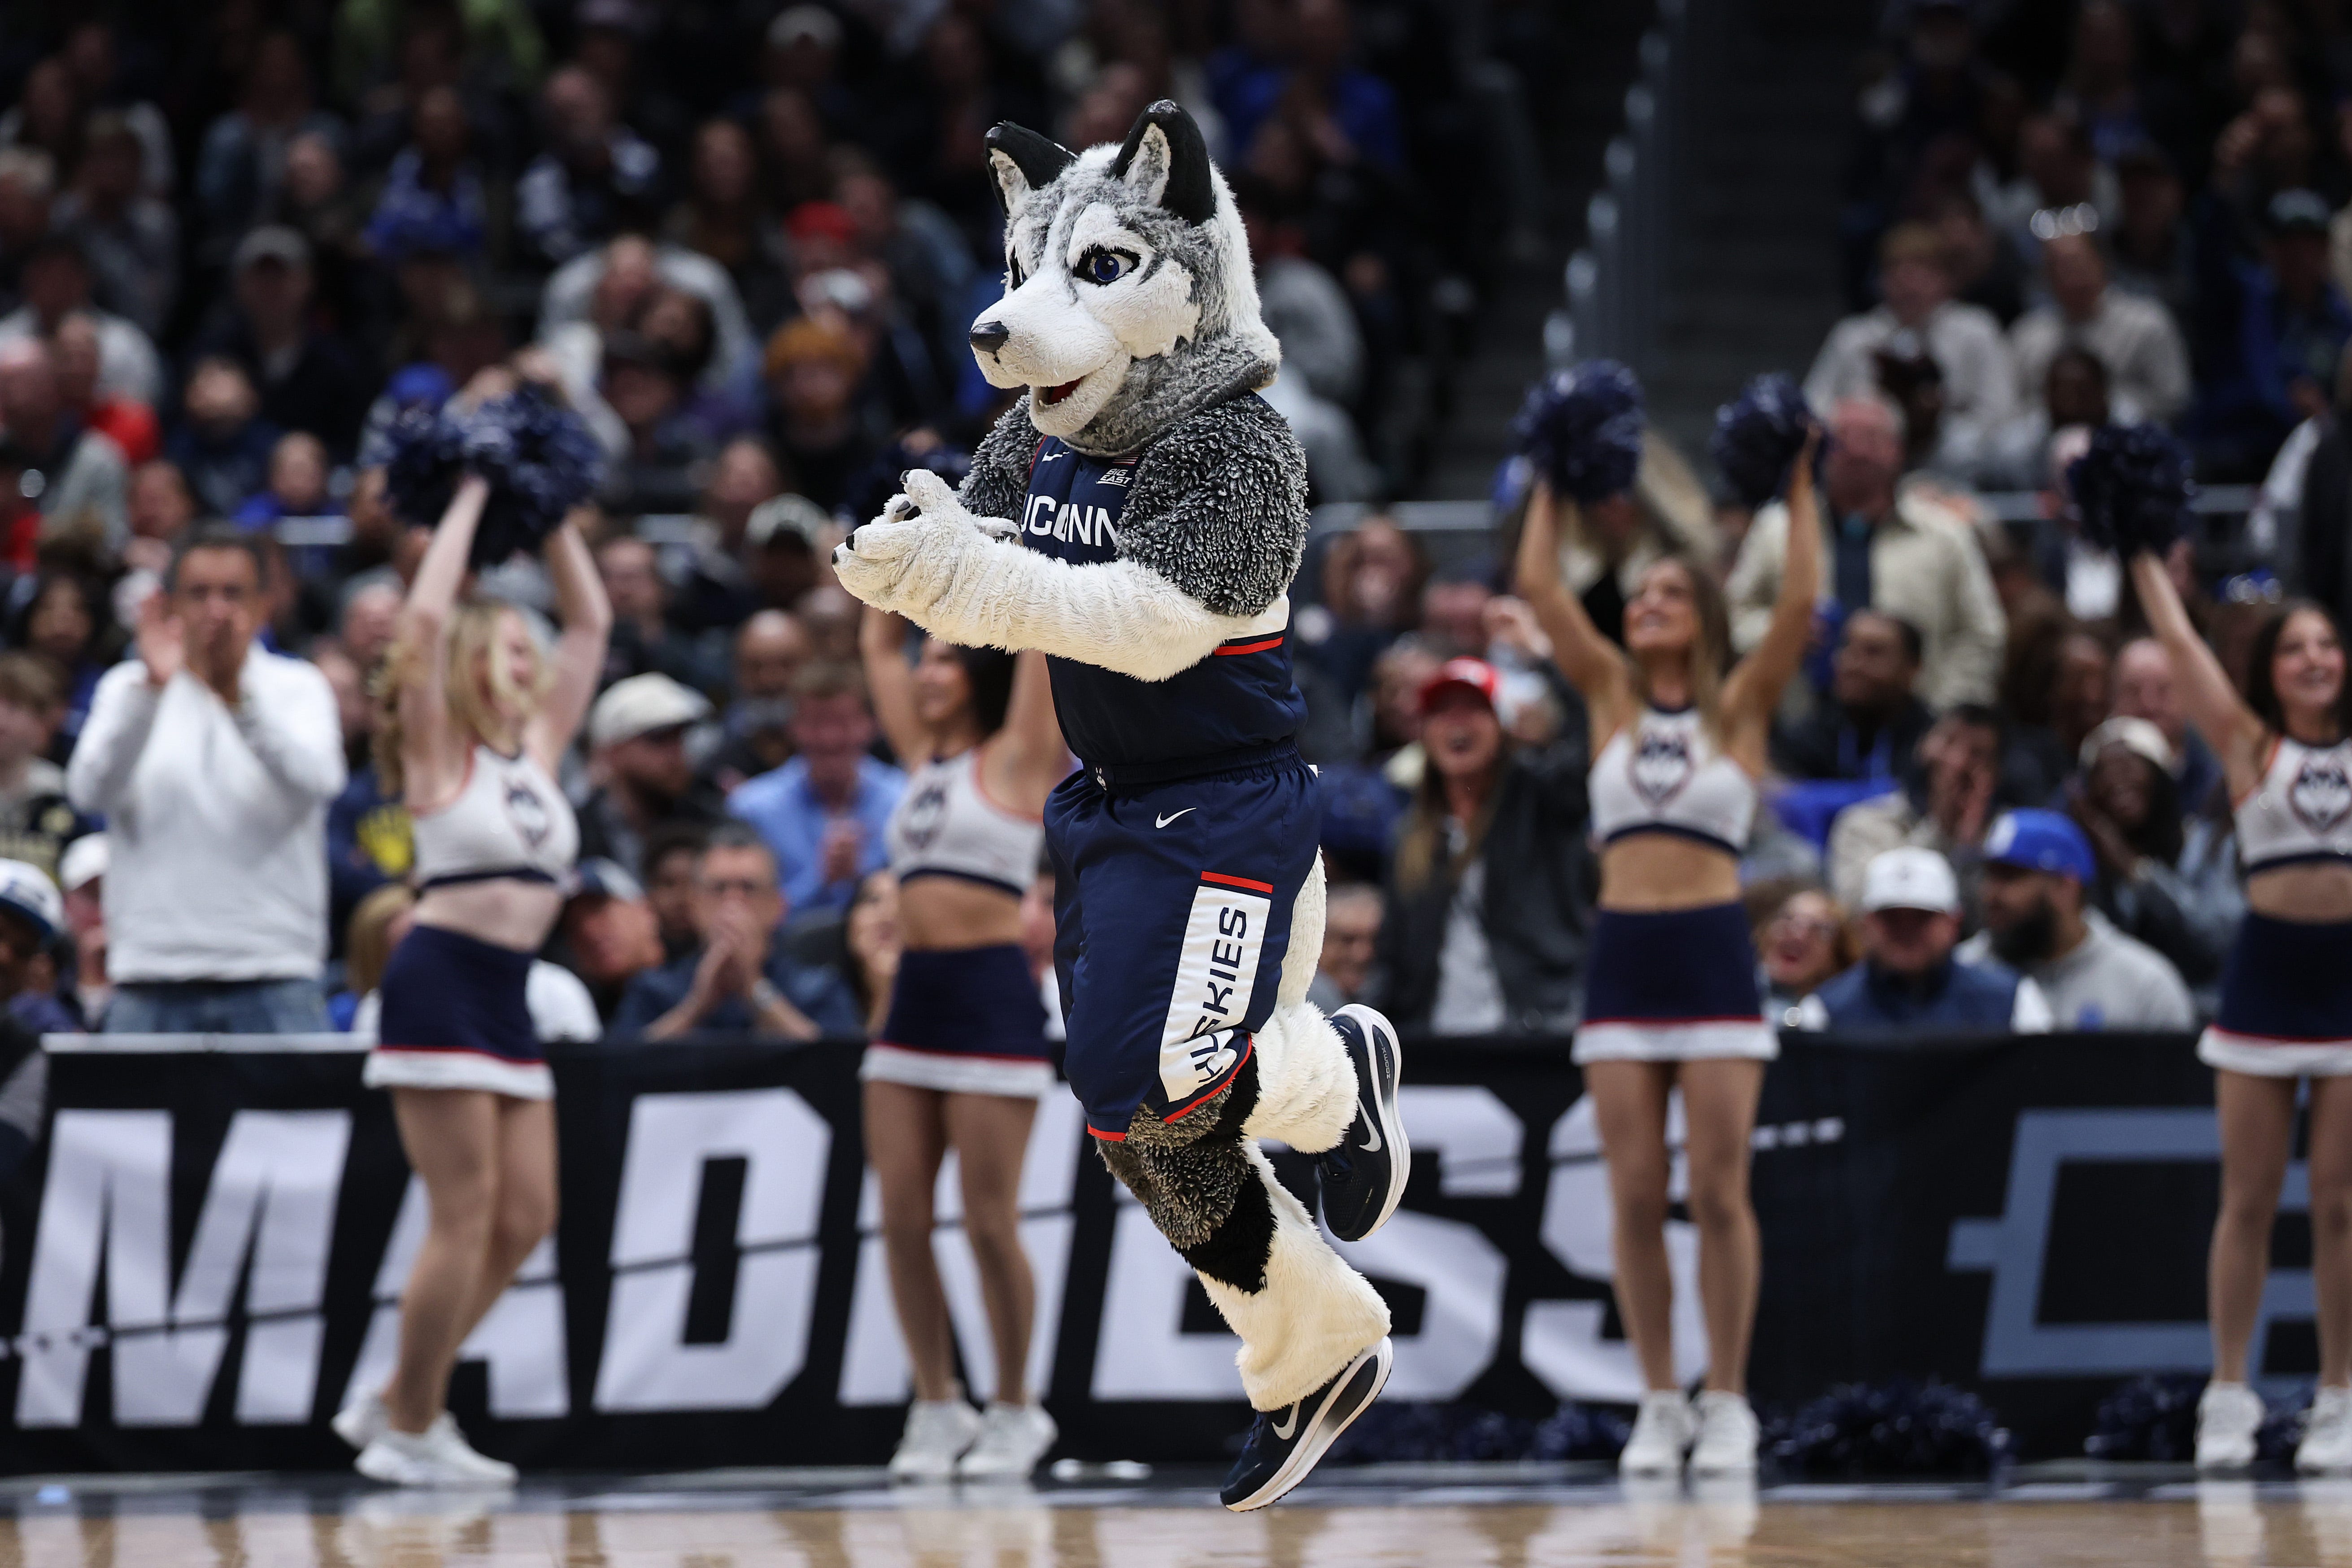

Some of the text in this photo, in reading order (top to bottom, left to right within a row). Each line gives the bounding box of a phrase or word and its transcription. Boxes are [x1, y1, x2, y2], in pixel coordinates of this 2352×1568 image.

[1106, 468, 1128, 476] BIG
[1099, 475, 1132, 484] EAST
[1190, 907, 1246, 1083] HUSKIES
